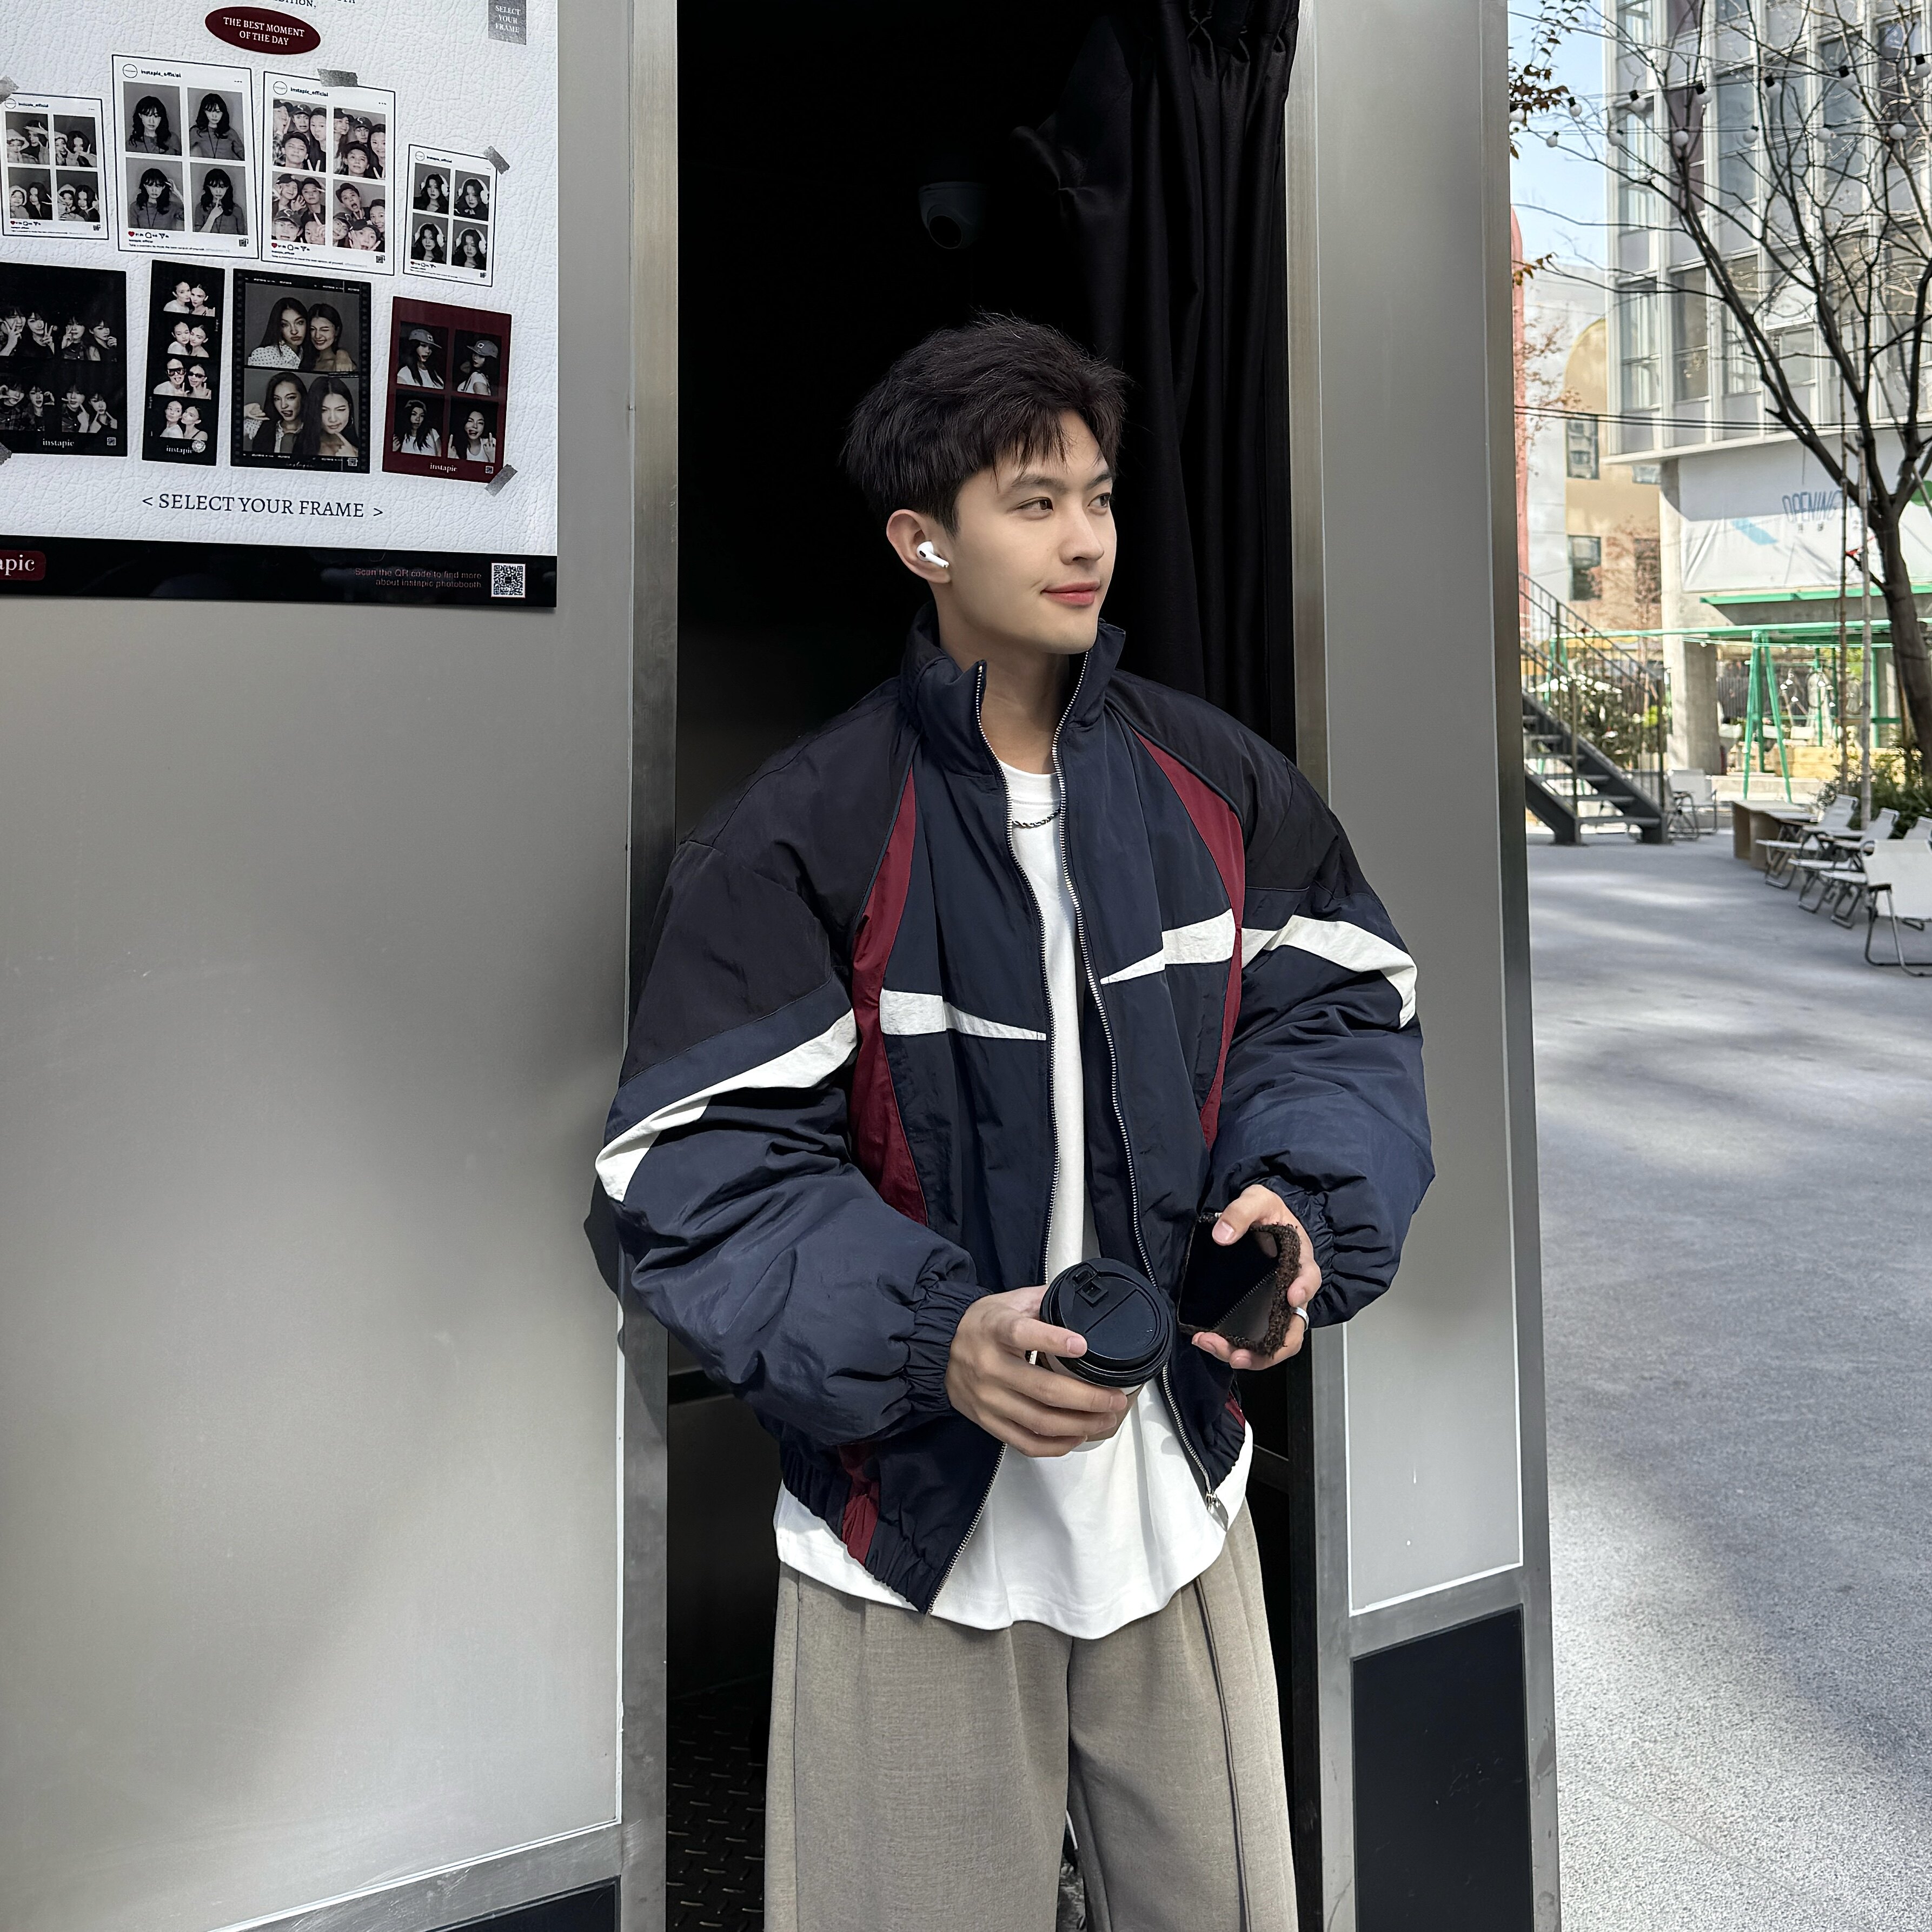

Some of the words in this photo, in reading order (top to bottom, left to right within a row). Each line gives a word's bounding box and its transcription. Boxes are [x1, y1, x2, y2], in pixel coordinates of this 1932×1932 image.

[273, 0, 316, 9] ION,
[495, 5, 521, 15] SELECT
[499, 14, 517, 24] YOUR
[223, 17, 241, 27] THE
[243, 20, 264, 31] BEST
[266, 24, 304, 37] MOMENT
[495, 23, 520, 32] FRAME
[239, 30, 251, 39] OF
[252, 32, 270, 42] THE
[272, 36, 289, 45] DAY
[43, 439, 75, 448] instapic
[430, 463, 458, 473] instapic
[159, 494, 234, 511] SELECT
[238, 497, 294, 515] YOUR
[299, 500, 364, 517] FRAME
[355, 568, 376, 576] Scan
[379, 568, 392, 576] the
[395, 569, 409, 577] QR
[411, 569, 431, 577] code
[444, 570, 459, 579] find
[436, 580, 481, 588] photobooth
